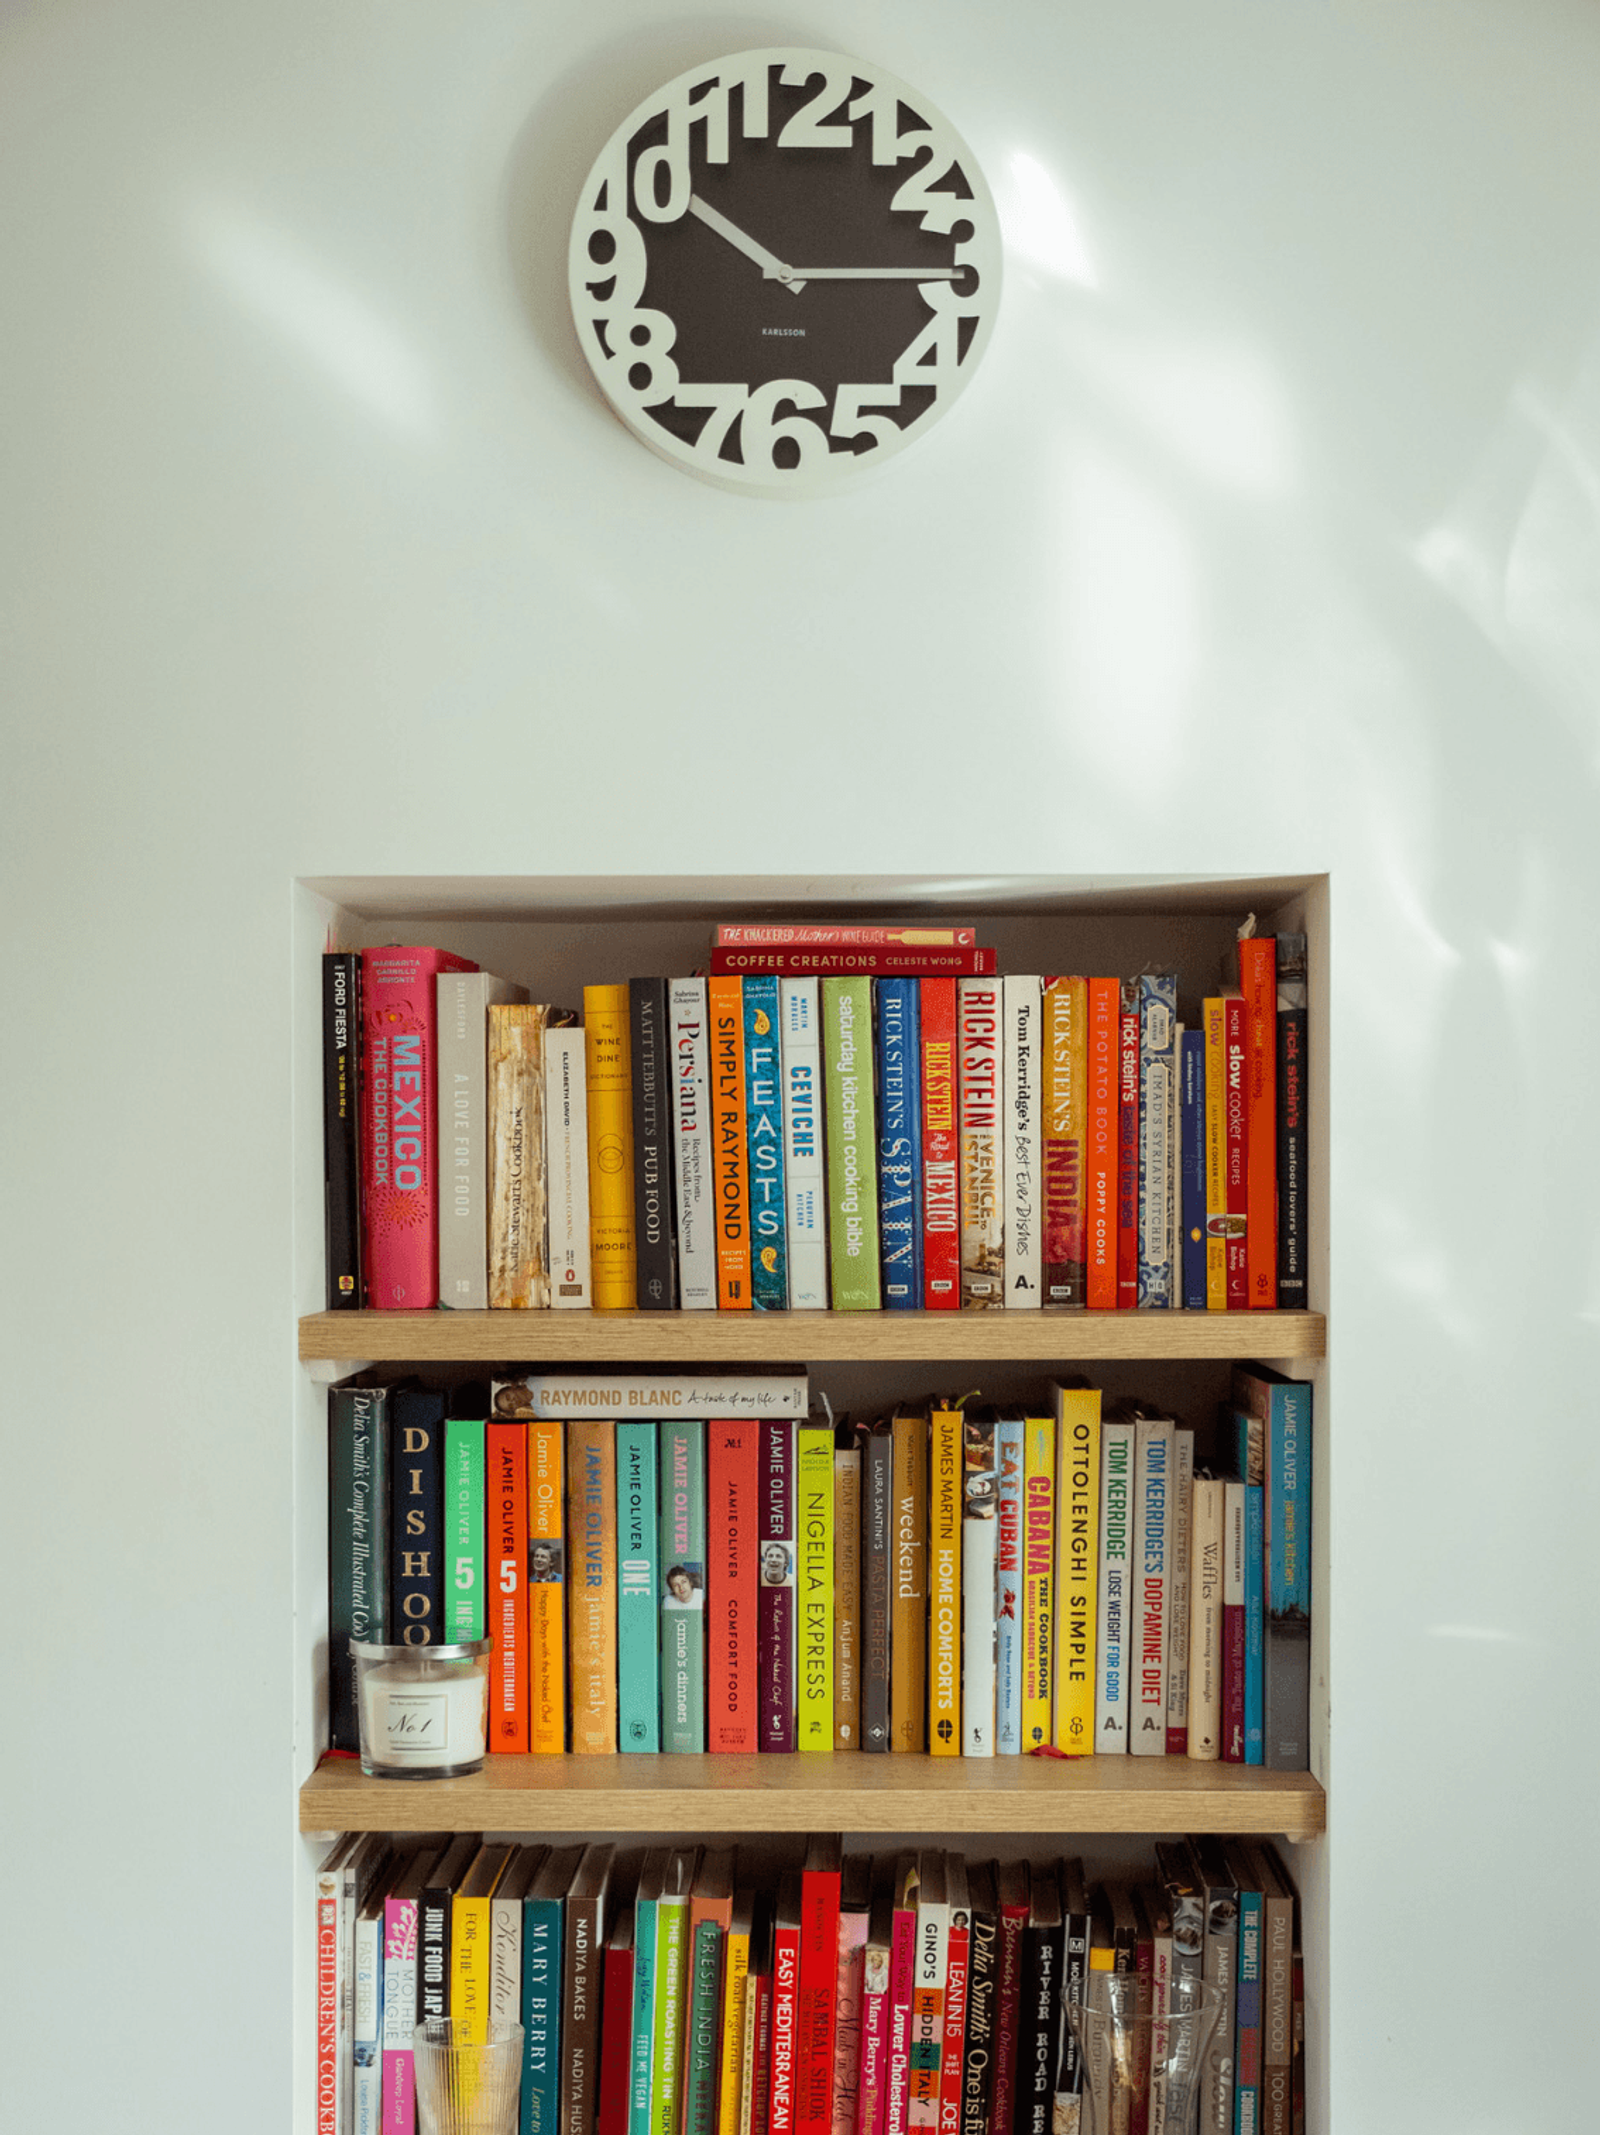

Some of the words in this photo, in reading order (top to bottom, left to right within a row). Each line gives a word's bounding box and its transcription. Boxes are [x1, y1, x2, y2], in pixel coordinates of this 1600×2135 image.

[762, 328, 806, 337] KARLSSON
[741, 379, 829, 470] 6
[830, 384, 903, 458] 5
[726, 955, 784, 966] COFFEE
[790, 955, 877, 967] CREATIONS
[886, 956, 927, 965] CELESTE
[930, 956, 962, 965] WONG
[334, 972, 346, 1006] FORD
[791, 996, 799, 1032] MORALES
[800, 998, 808, 1029] MARTIN
[1096, 992, 1108, 1023] THE
[335, 1009, 347, 1049] FIESTA
[596, 1038, 620, 1046] WINE
[640, 1000, 655, 1047] MATT
[837, 996, 855, 1072] saturday
[885, 998, 903, 1047] RICK
[964, 992, 995, 1051] RICK
[1053, 994, 1070, 1048] RICK
[1231, 1010, 1240, 1036] MORE
[374, 1038, 387, 1073] THE
[677, 1021, 702, 1132] Persiana
[718, 1017, 738, 1102] SIMPLY
[925, 1042, 951, 1080] RICK
[1096, 1031, 1108, 1099] POTATO
[1229, 1045, 1244, 1088] slow
[393, 1035, 421, 1190] MEXICO
[642, 1050, 657, 1136] TEBBUTT'S
[791, 1066, 814, 1157] CEVICHE
[841, 1076, 858, 1140] kitchen
[885, 1051, 905, 1129] STEIN'S
[926, 1081, 952, 1130] STEIN
[964, 1058, 996, 1128] STEIN
[1053, 1049, 1071, 1132] STEIN'S
[375, 1077, 388, 1185] COOKBOOK
[1096, 1107, 1107, 1155] BOOK
[1229, 1092, 1243, 1139] cooker
[644, 1145, 659, 1184] PUB
[752, 1048, 779, 1235] FEASTS
[1232, 1148, 1241, 1185] RECIPES
[721, 1112, 741, 1239] RAYMOND
[841, 1145, 860, 1213] cooking
[925, 1160, 956, 1231] MEXICO
[1046, 1139, 1079, 1228] INDIA
[1096, 1172, 1106, 1213] POPPY
[645, 1190, 660, 1243] FOOD
[805, 1191, 814, 1229] PERUVIAN
[880, 1138, 913, 1267] SPAIN
[845, 1217, 862, 1256] bible
[1096, 1219, 1106, 1265] COOKS
[354, 1397, 370, 1432] Delia
[353, 1435, 370, 1477] Smith's
[458, 1442, 470, 1485] JAMIE
[502, 1447, 514, 1493] JAMIE
[537, 1432, 552, 1478] Jamie
[586, 1445, 601, 1504] JAMIE
[629, 1445, 641, 1490] JAMIE
[674, 1436, 687, 1488] JAMIE
[940, 1425, 953, 1475] JAMES
[1001, 1442, 1018, 1494] EAT
[1108, 1440, 1128, 1474] TOM
[1147, 1439, 1166, 1474] TOM
[1180, 1445, 1188, 1469] THE
[347, 1481, 370, 1537] Complete
[458, 1491, 469, 1544] OLIVER
[537, 1484, 553, 1532] Oliver
[728, 1481, 737, 1522] JAMIE
[940, 1480, 953, 1540] MARTIN
[1070, 1424, 1090, 1583] OTTOLENGHI
[1179, 1474, 1188, 1514] HAIRY
[502, 1500, 514, 1554] OLIVER
[630, 1495, 641, 1551] OLIVER
[674, 1493, 687, 1554] OLIVER
[807, 1492, 825, 1592] NIGELLA
[999, 1499, 1019, 1572] CUBAN
[1027, 1476, 1051, 1575] CABANA
[1106, 1479, 1127, 1560] KERRIDGE
[1145, 1478, 1165, 1573] KERRIDGE'S
[586, 1512, 602, 1587] OLIVER
[728, 1528, 737, 1578] OLIVER
[1176, 1518, 1187, 1573] DIETERS
[1202, 1542, 1217, 1599] Waffles
[352, 1541, 371, 1607] Illustrated
[455, 1556, 474, 1589] 5
[500, 1560, 517, 1592] 5
[622, 1560, 650, 1595] ONE
[939, 1549, 953, 1603] HOME
[1039, 1577, 1048, 1610] THE
[1108, 1570, 1122, 1597] LOSE
[503, 1599, 514, 1648] INGREDIENTS
[539, 1590, 549, 1617] Happy
[1108, 1600, 1121, 1643] WEIGHT
[1142, 1578, 1163, 1664] DOPAMINE
[1204, 1607, 1212, 1624] from
[540, 1619, 549, 1639] Days
[541, 1642, 550, 1658] with
[586, 1596, 604, 1666] jamie's
[674, 1619, 688, 1667] jamie's
[728, 1600, 738, 1667] COMFORT
[807, 1602, 825, 1700] EXPRESS
[1070, 1596, 1086, 1682] SIMPLE
[1203, 1626, 1212, 1658] morning
[503, 1651, 515, 1711] MEDITERRANEAN
[541, 1660, 550, 1672] the
[939, 1608, 953, 1709] COMFORTS
[1038, 1613, 1049, 1700] COOKBOOK
[1107, 1646, 1120, 1667] FOR
[541, 1674, 551, 1702] Naked
[586, 1674, 605, 1716] italy
[676, 1670, 689, 1722] dinners
[728, 1673, 738, 1712] FOOD
[1106, 1671, 1119, 1701] GOOD
[1142, 1669, 1161, 1706] DIET
[1202, 1669, 1213, 1703] midnight
[542, 1703, 551, 1723] Chef
[574, 1918, 588, 1971] NADIYA
[734, 1949, 745, 1970] silk
[924, 1923, 938, 1979] GINO'S
[973, 1921, 996, 1973] Delia
[1272, 1917, 1285, 1953] PAUL
[320, 1929, 335, 2053] CHILDREN'S
[733, 1976, 744, 2002] road
[778, 1948, 794, 1989] EASY
[1038, 1945, 1053, 2019] RIVER
[386, 1971, 399, 2040] TONGUE
[401, 1969, 414, 2039] MOTHER
[574, 1976, 586, 2021] BAKES
[970, 1975, 993, 2044] Smith's
[1271, 1960, 1285, 2052] HOLLYWOOD
[727, 2005, 741, 2073] vegetarian
[920, 1996, 934, 2058] HIDDEN
[571, 2048, 584, 2100] NADIYA
[773, 1994, 792, 2129] MEDITERRANEAN
[917, 2066, 930, 2107] ITALY
[967, 2049, 988, 2094] One
[1035, 2033, 1048, 2091] ROAD
[1271, 2072, 1284, 2101] 100
[966, 2097, 984, 2111] is
